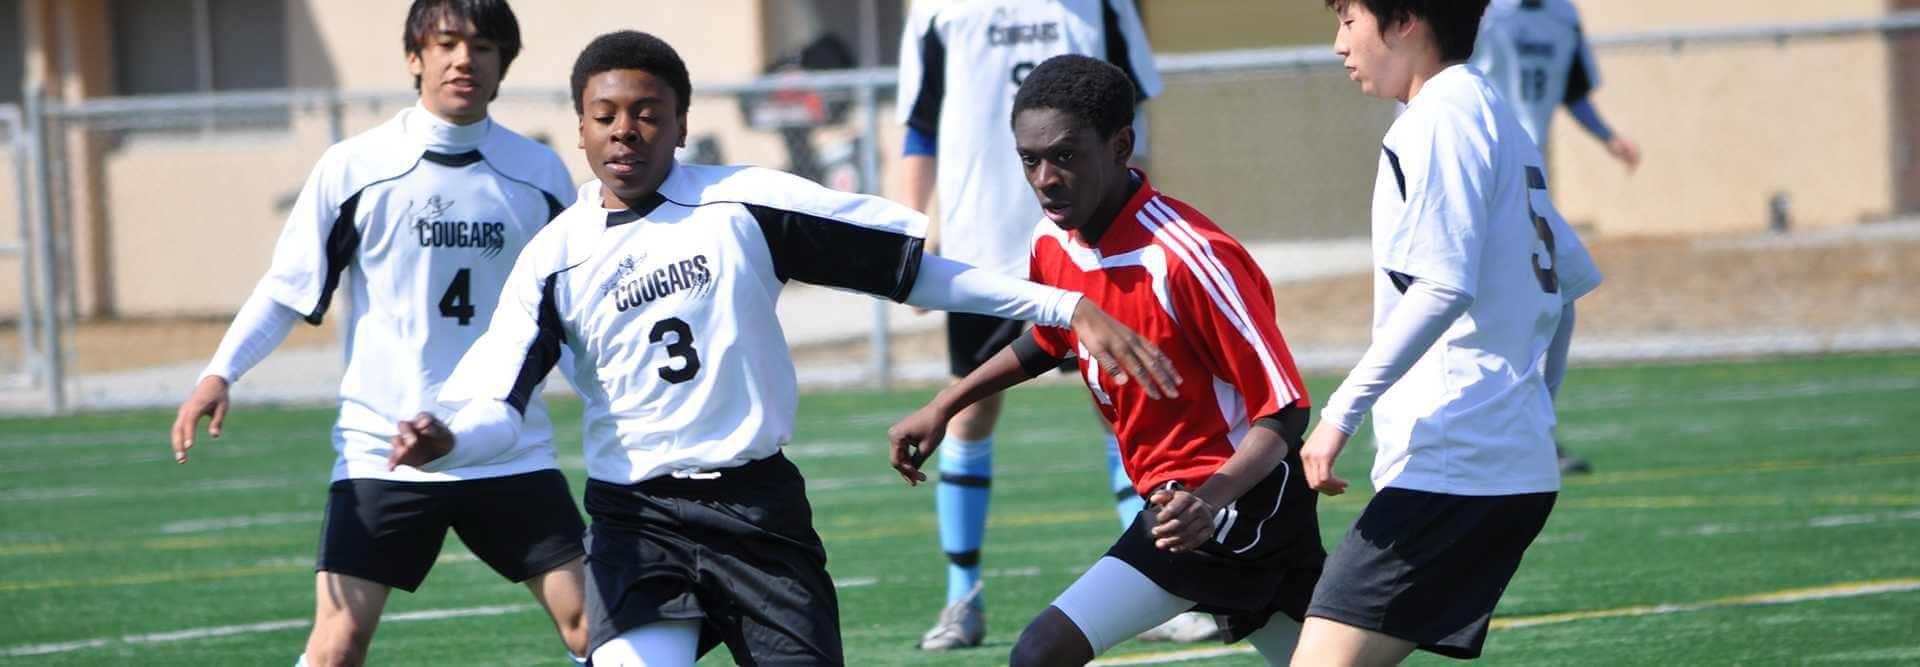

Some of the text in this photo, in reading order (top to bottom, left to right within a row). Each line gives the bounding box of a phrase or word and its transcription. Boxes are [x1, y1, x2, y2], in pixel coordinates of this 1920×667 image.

[419, 219, 505, 249] COUGARS
[1524, 165, 1558, 294] 5
[438, 268, 475, 326] 4
[614, 254, 712, 312] COUGARS
[648, 316, 701, 384] 3
